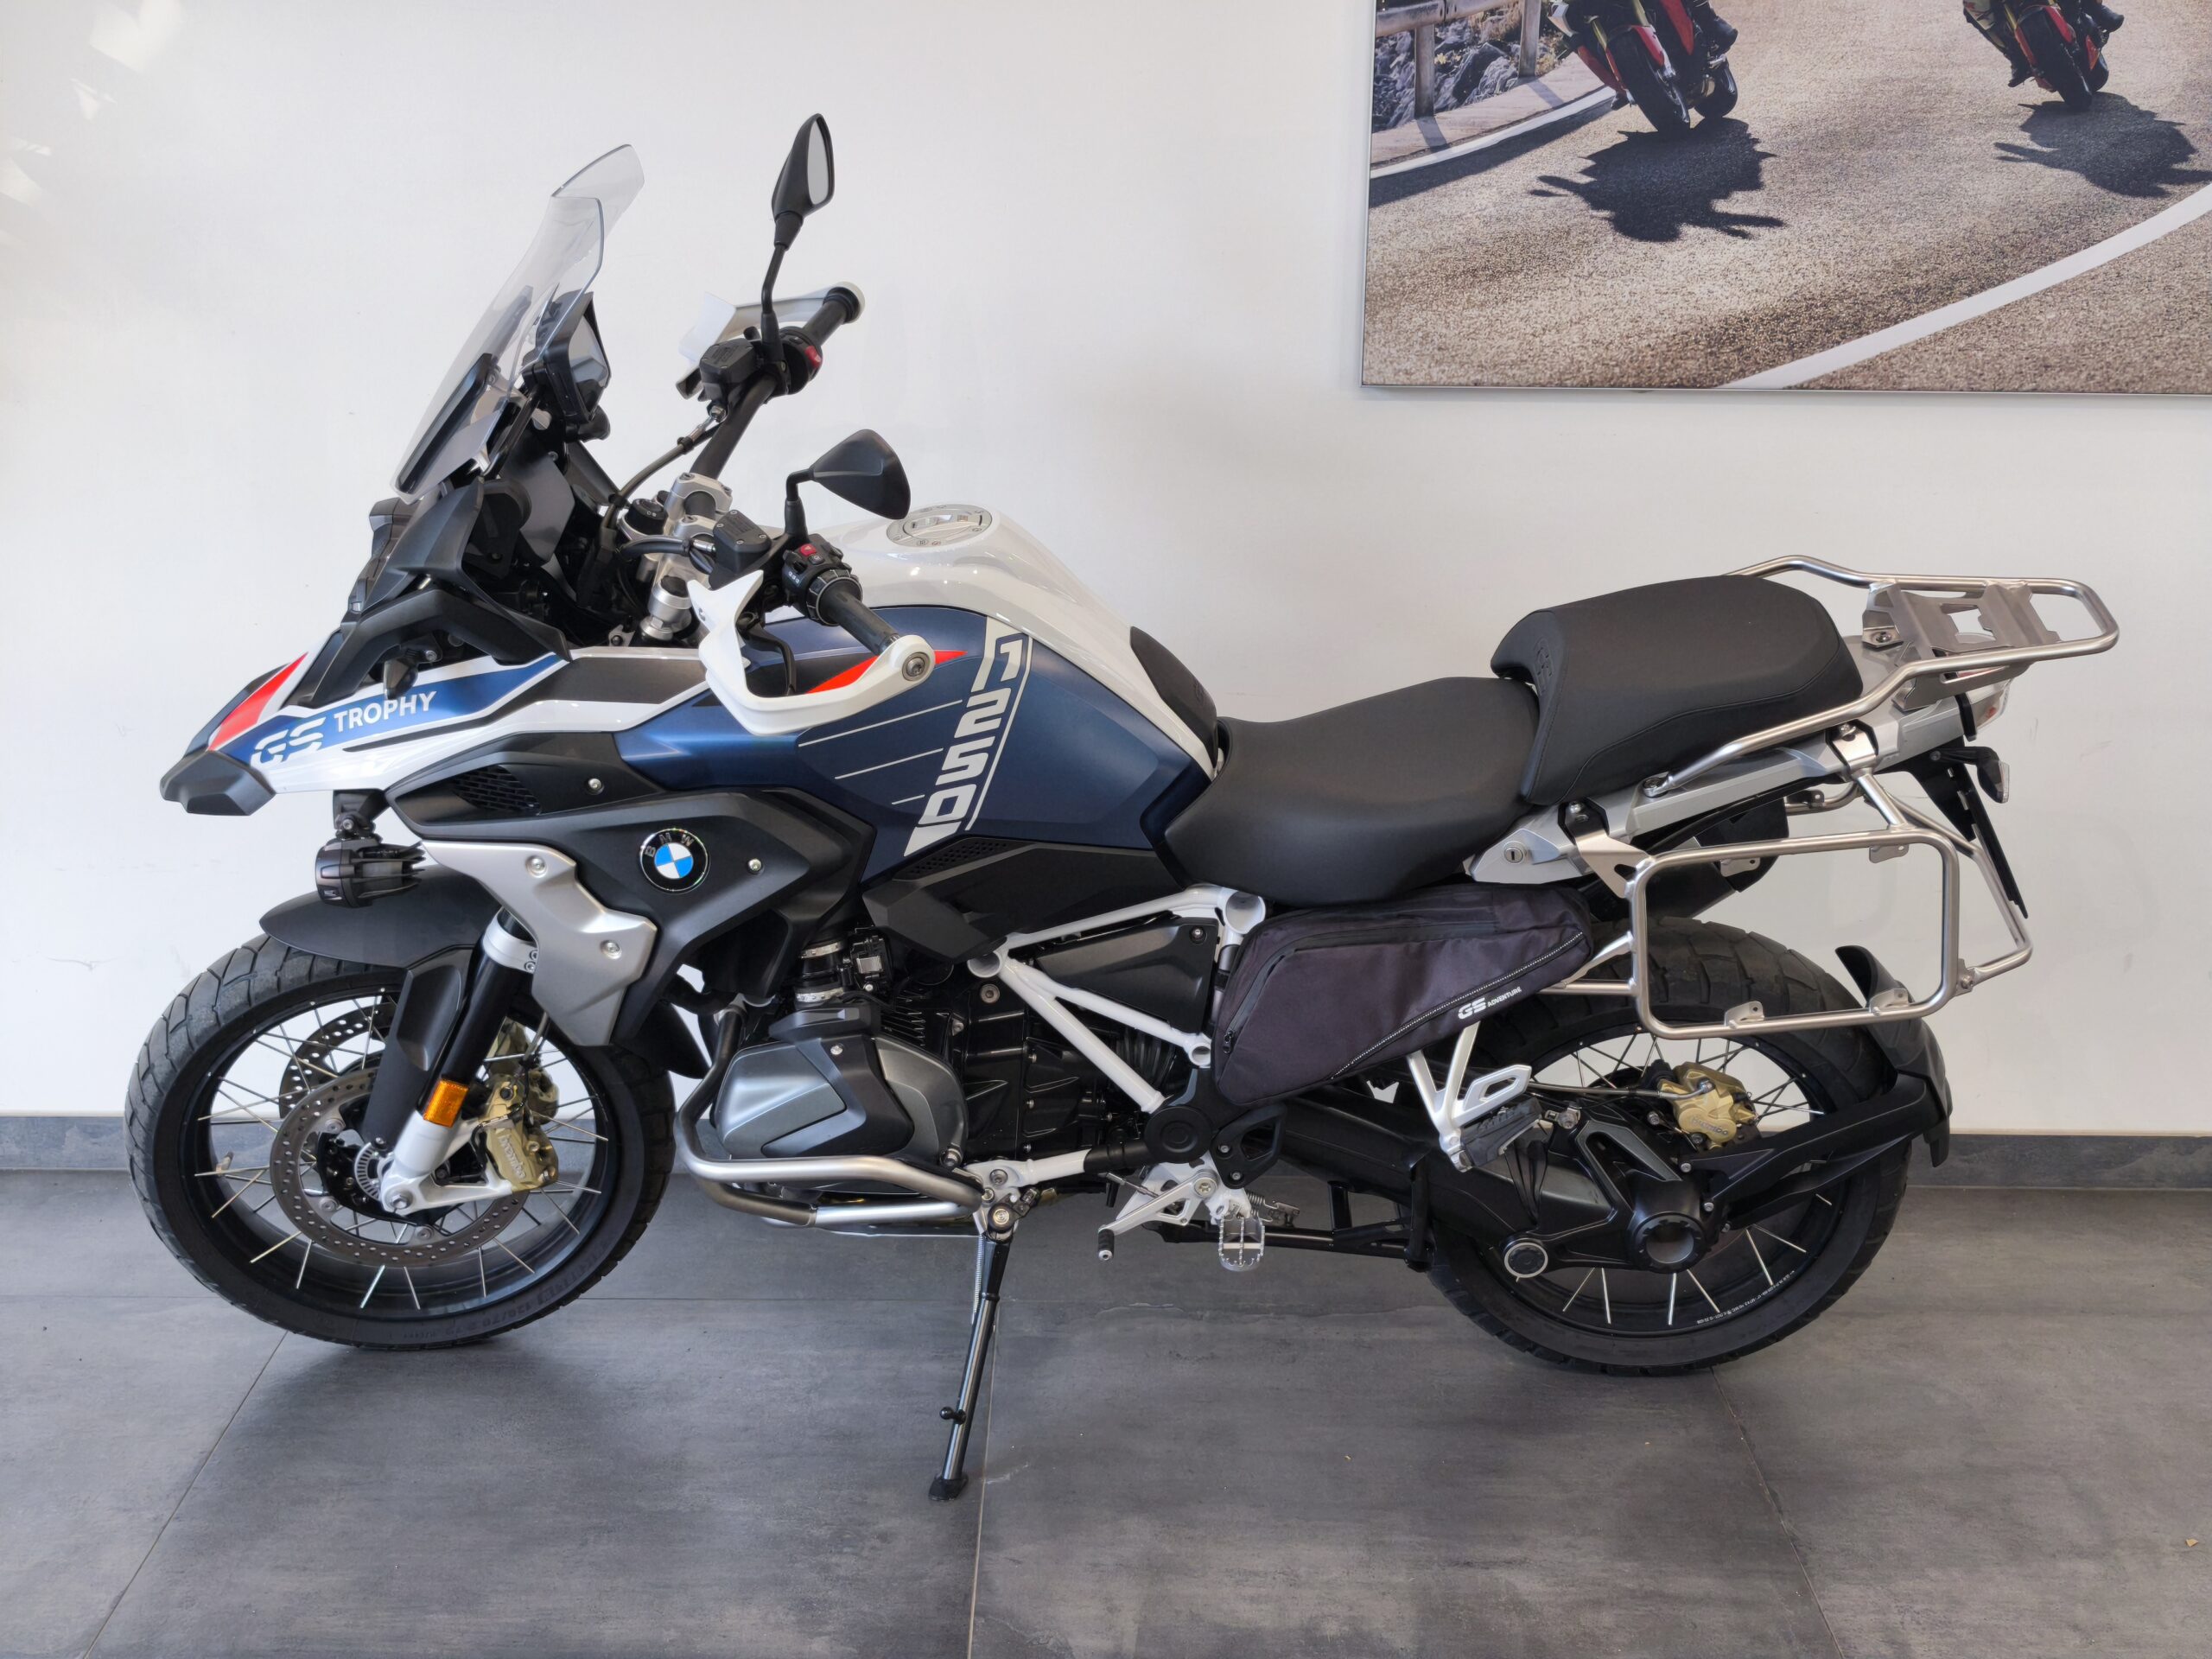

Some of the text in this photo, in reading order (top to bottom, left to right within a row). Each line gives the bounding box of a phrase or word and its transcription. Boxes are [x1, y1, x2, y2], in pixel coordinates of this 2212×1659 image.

[251, 690, 436, 767] GS TROPHY
[918, 639, 1023, 825] 1250
[645, 832, 695, 857] BMW
[1458, 986, 1522, 1019] GS ADVENTURE
